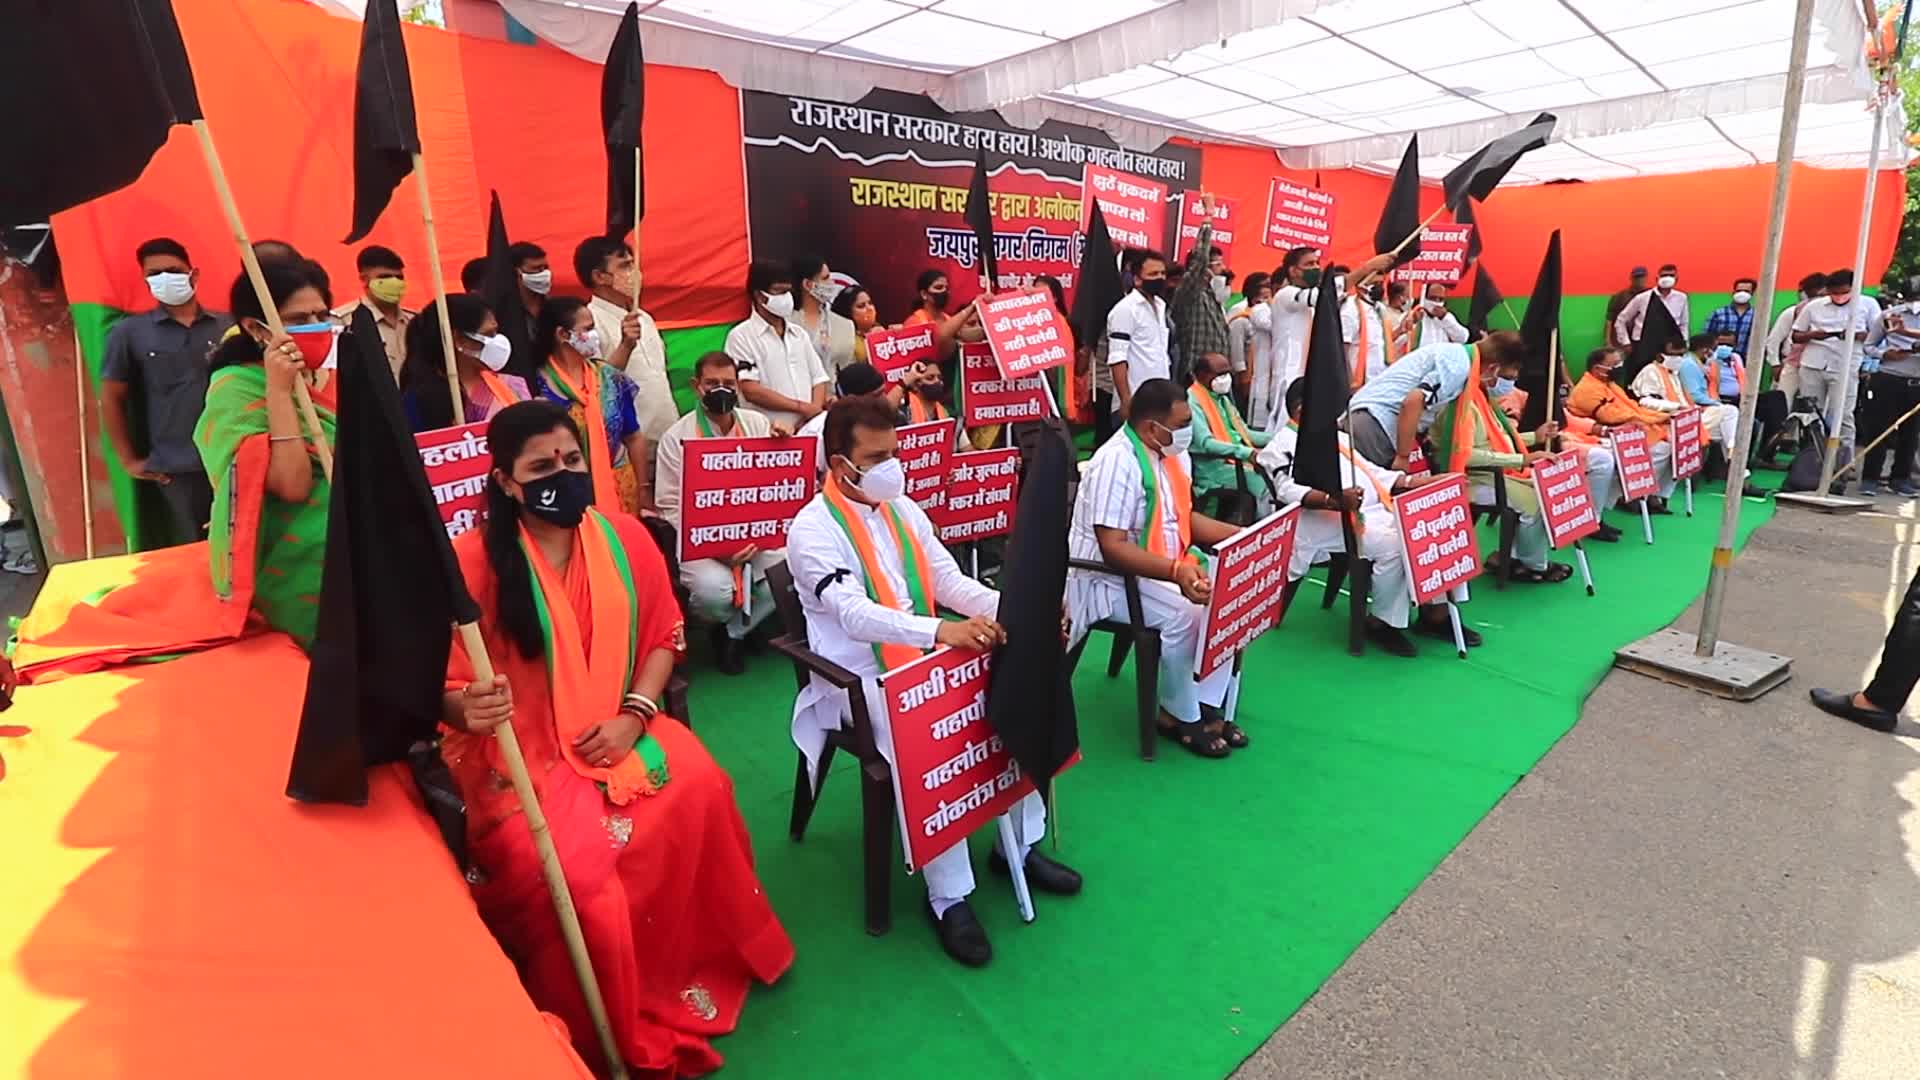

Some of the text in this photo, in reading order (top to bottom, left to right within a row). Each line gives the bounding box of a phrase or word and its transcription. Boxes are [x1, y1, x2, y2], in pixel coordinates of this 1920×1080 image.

[789, 97, 890, 136] राजस्थान
[892, 114, 961, 146] सरकार
[962, 125, 996, 152] हाय
[1040, 135, 1085, 164] अशोक
[1087, 146, 1134, 172] गहलोत
[1134, 153, 1159, 176] हाय
[850, 178, 938, 210] राजस्थान
[1000, 194, 1031, 220] द्वारा
[1022, 226, 1070, 261] निगम
[700, 445, 803, 471] गहलोत सरकार
[1404, 484, 1462, 516] आपातकाल
[690, 522, 748, 547] भ्रष्टाचार
[1409, 518, 1427, 541] की
[1438, 529, 1469, 556] चलेगी
[898, 666, 947, 713] आधी
[946, 657, 981, 689] रात
[922, 740, 990, 792] गहलोत
[922, 758, 1022, 838] लोकतंत्र की
